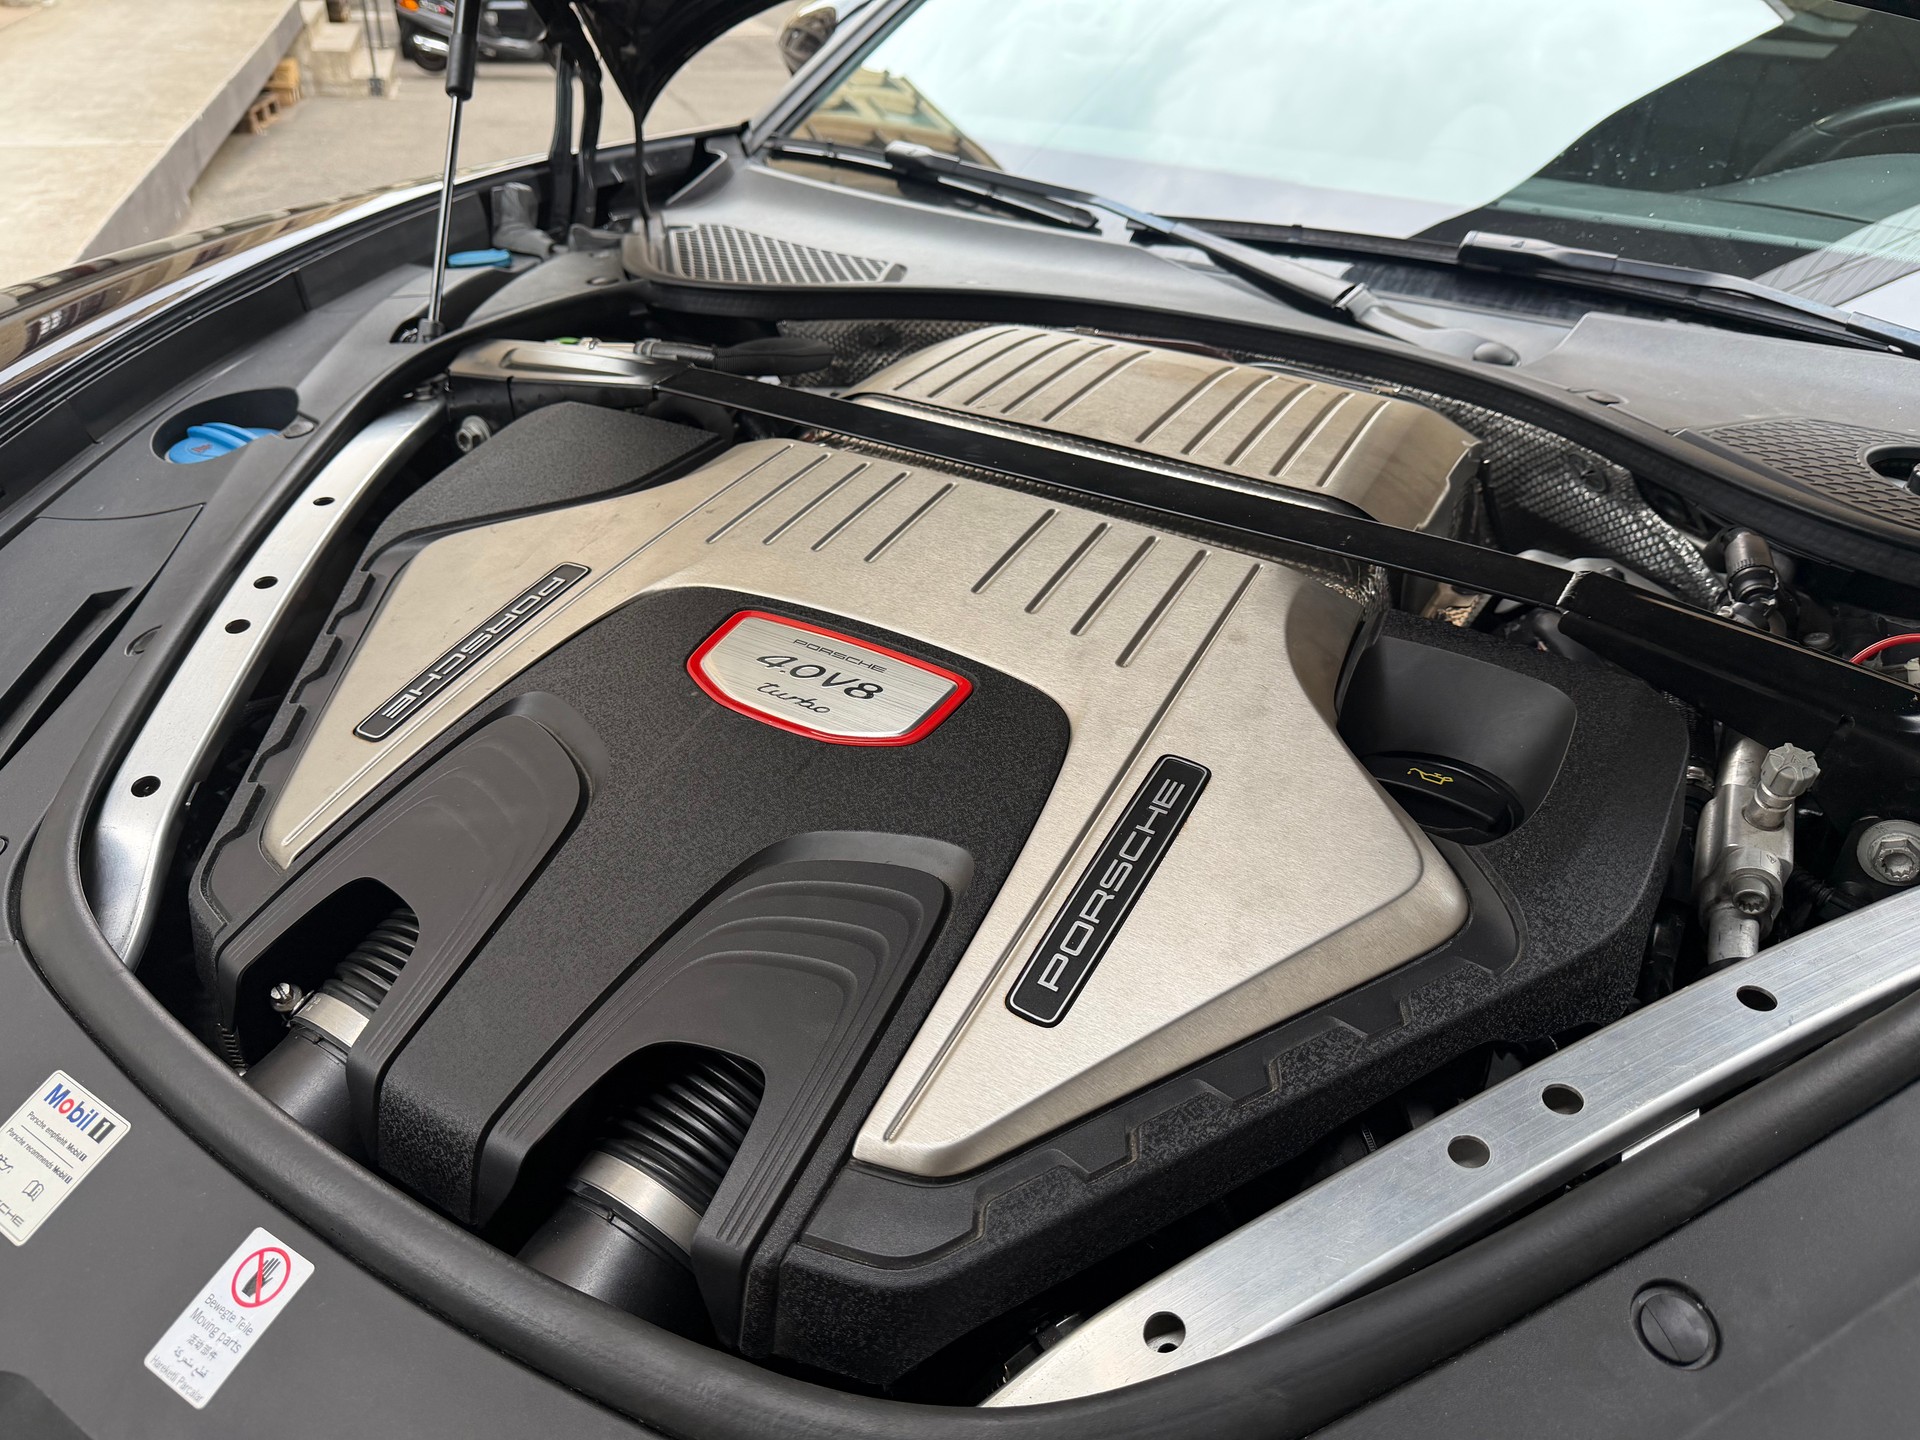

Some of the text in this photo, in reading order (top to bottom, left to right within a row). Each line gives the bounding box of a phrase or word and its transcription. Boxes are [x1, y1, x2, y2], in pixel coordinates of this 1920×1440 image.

[381, 576, 566, 719] PORSCHE
[792, 638, 888, 674] PORSCHE
[756, 681, 831, 714] turbo
[1037, 778, 1186, 992] PORSCHE
[26, 1110, 47, 1130] Porsche
[43, 1082, 100, 1132] Mobil
[6, 1127, 26, 1146] Porsche
[24, 1143, 54, 1170] recommends
[0, 1202, 25, 1228] CHE
[190, 1307, 242, 1354] Moving parts
[204, 1293, 254, 1336] Bewegte Teile
